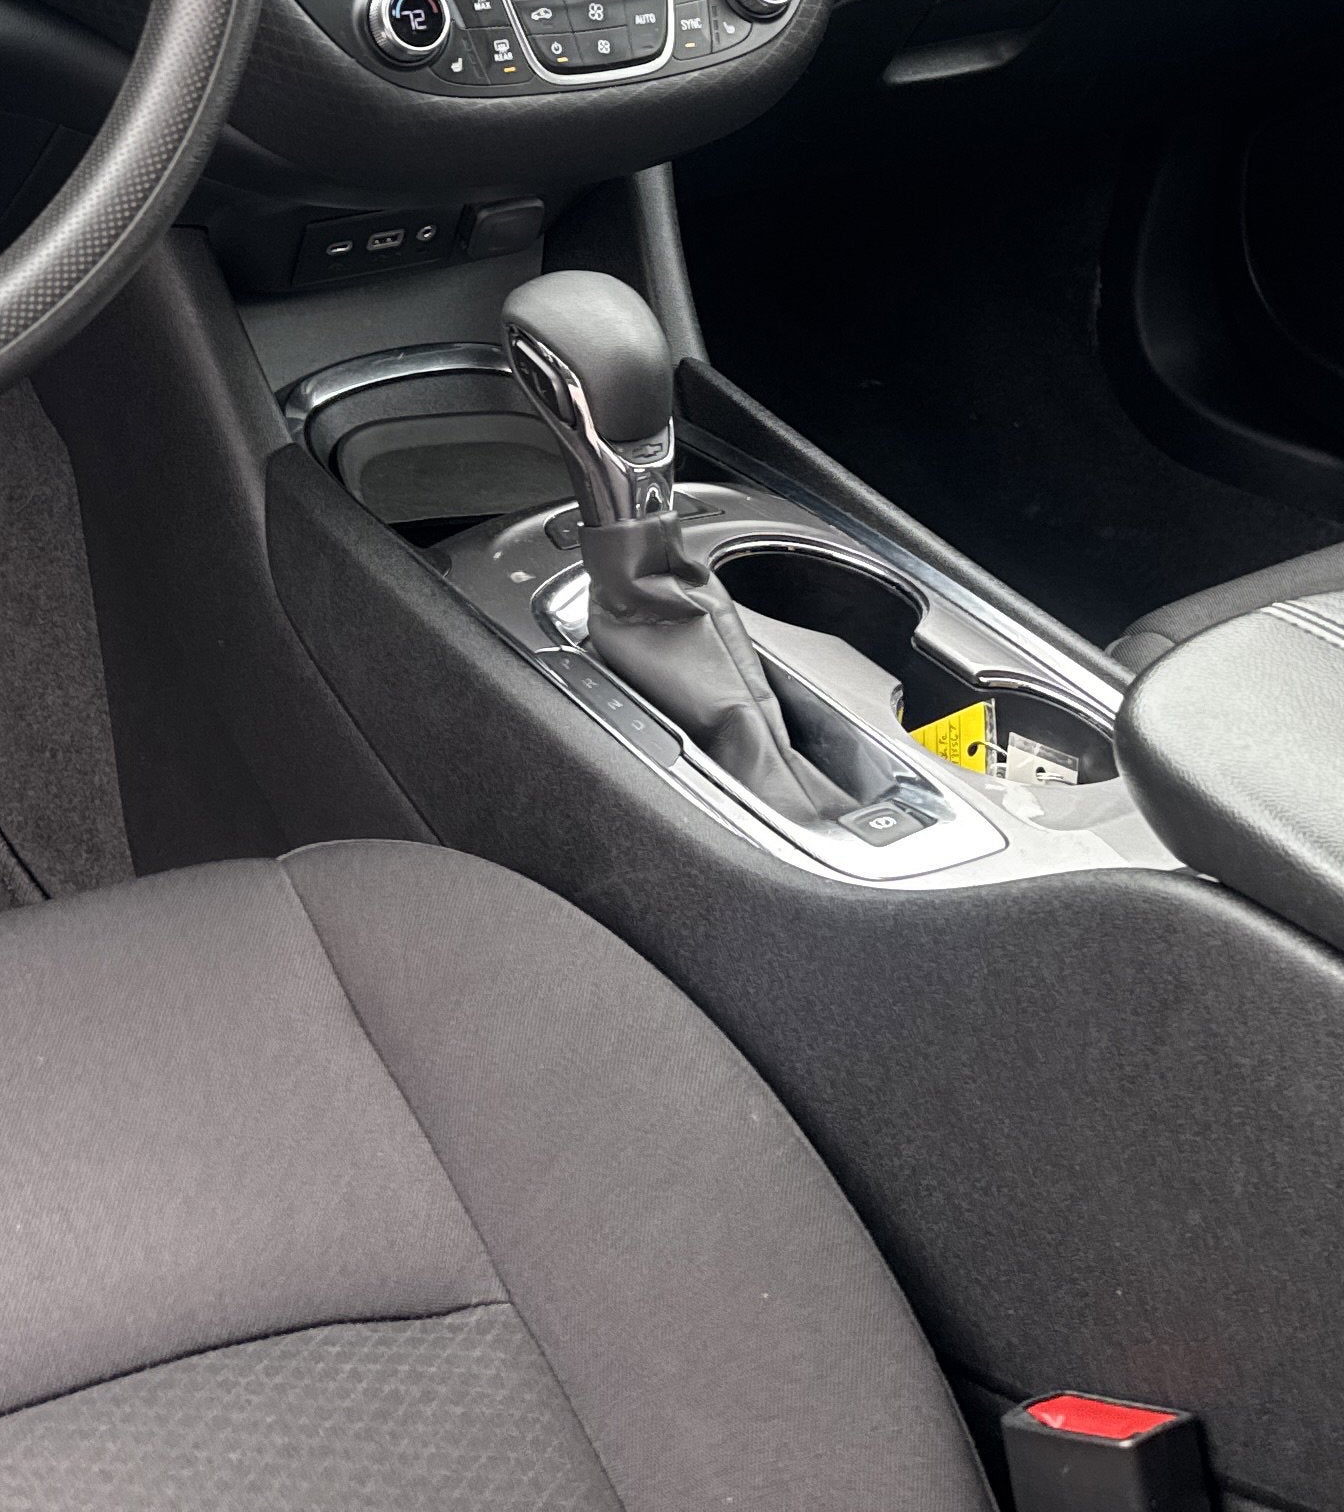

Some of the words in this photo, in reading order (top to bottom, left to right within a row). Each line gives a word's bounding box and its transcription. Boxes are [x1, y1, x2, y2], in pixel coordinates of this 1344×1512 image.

[474, 2, 491, 11] MAX
[400, 9, 427, 30] 72
[635, 13, 656, 25] AUTO
[680, 17, 702, 31] SYNC
